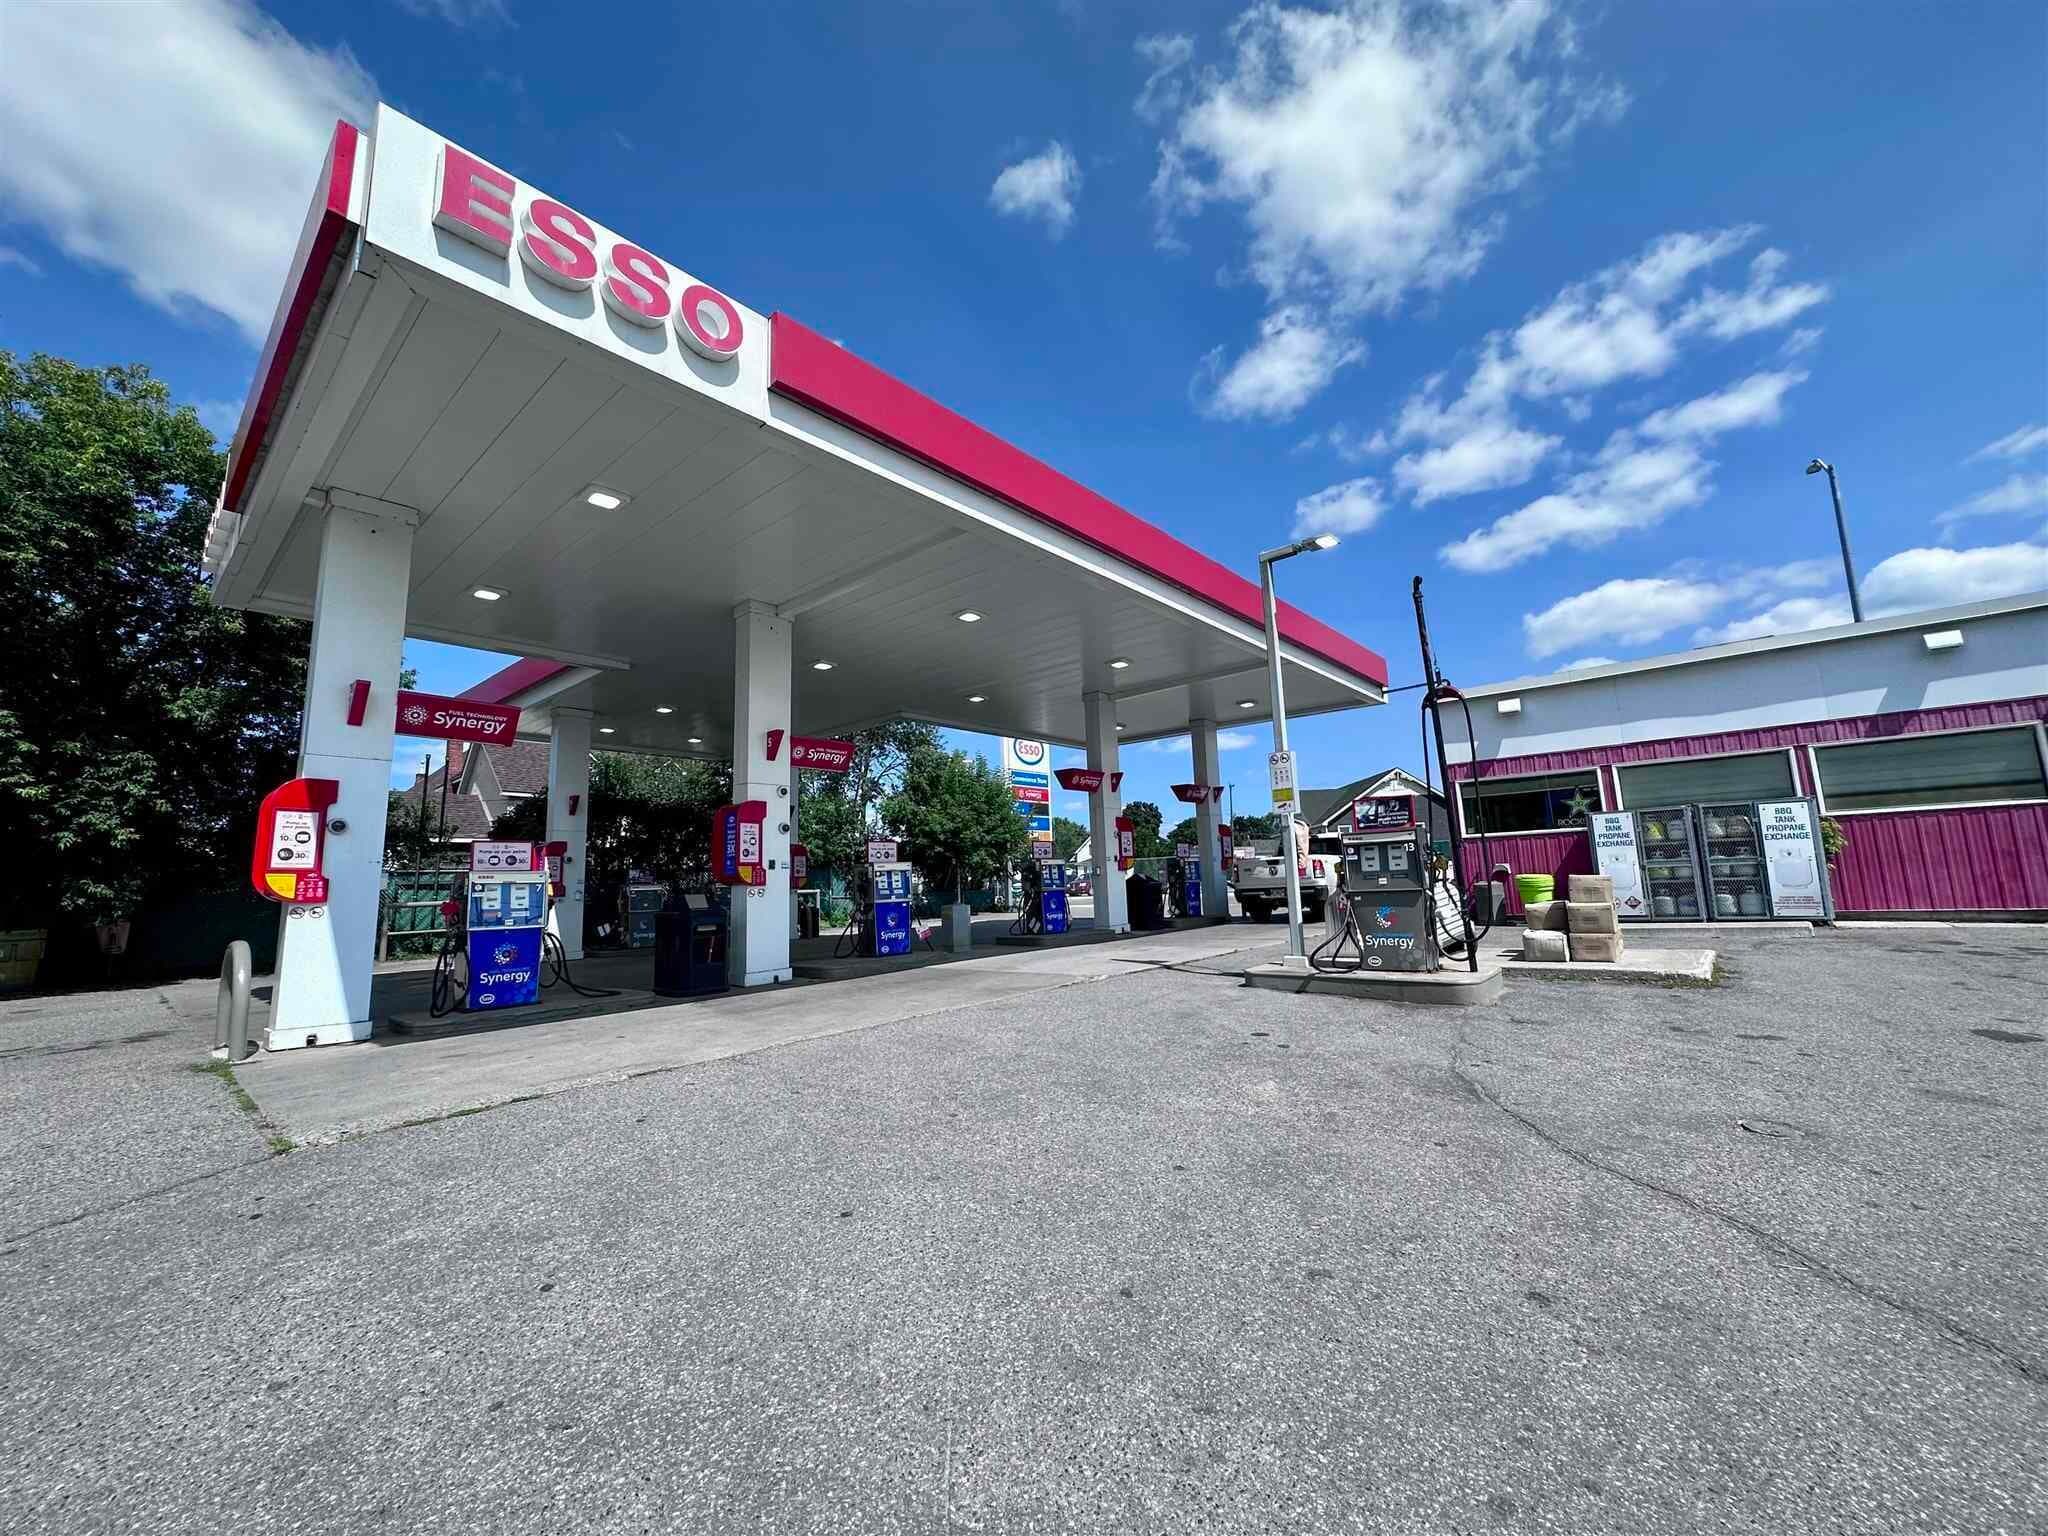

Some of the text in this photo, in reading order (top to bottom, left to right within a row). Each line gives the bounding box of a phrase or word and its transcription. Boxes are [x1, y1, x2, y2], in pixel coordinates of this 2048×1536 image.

[433, 143, 743, 360] ESSO
[449, 709, 464, 717] FUEL
[433, 711, 506, 735] Synergy
[807, 748, 846, 764] Synergy
[1775, 807, 1792, 815] BBQ
[1605, 817, 1620, 825] BBQ
[1775, 815, 1796, 823] TANK
[1605, 824, 1623, 832] TANK
[1766, 824, 1807, 832] PROPANE
[1598, 832, 1631, 840] PROPANE
[1764, 832, 1811, 841] EXCHANGE
[1403, 842, 1415, 852] 13
[1597, 839, 1635, 848] EXCHANGE
[536, 884, 542, 892] 7
[880, 930, 906, 941] Synergy
[1365, 934, 1415, 950] Synergy
[480, 971, 531, 986] Synergy
